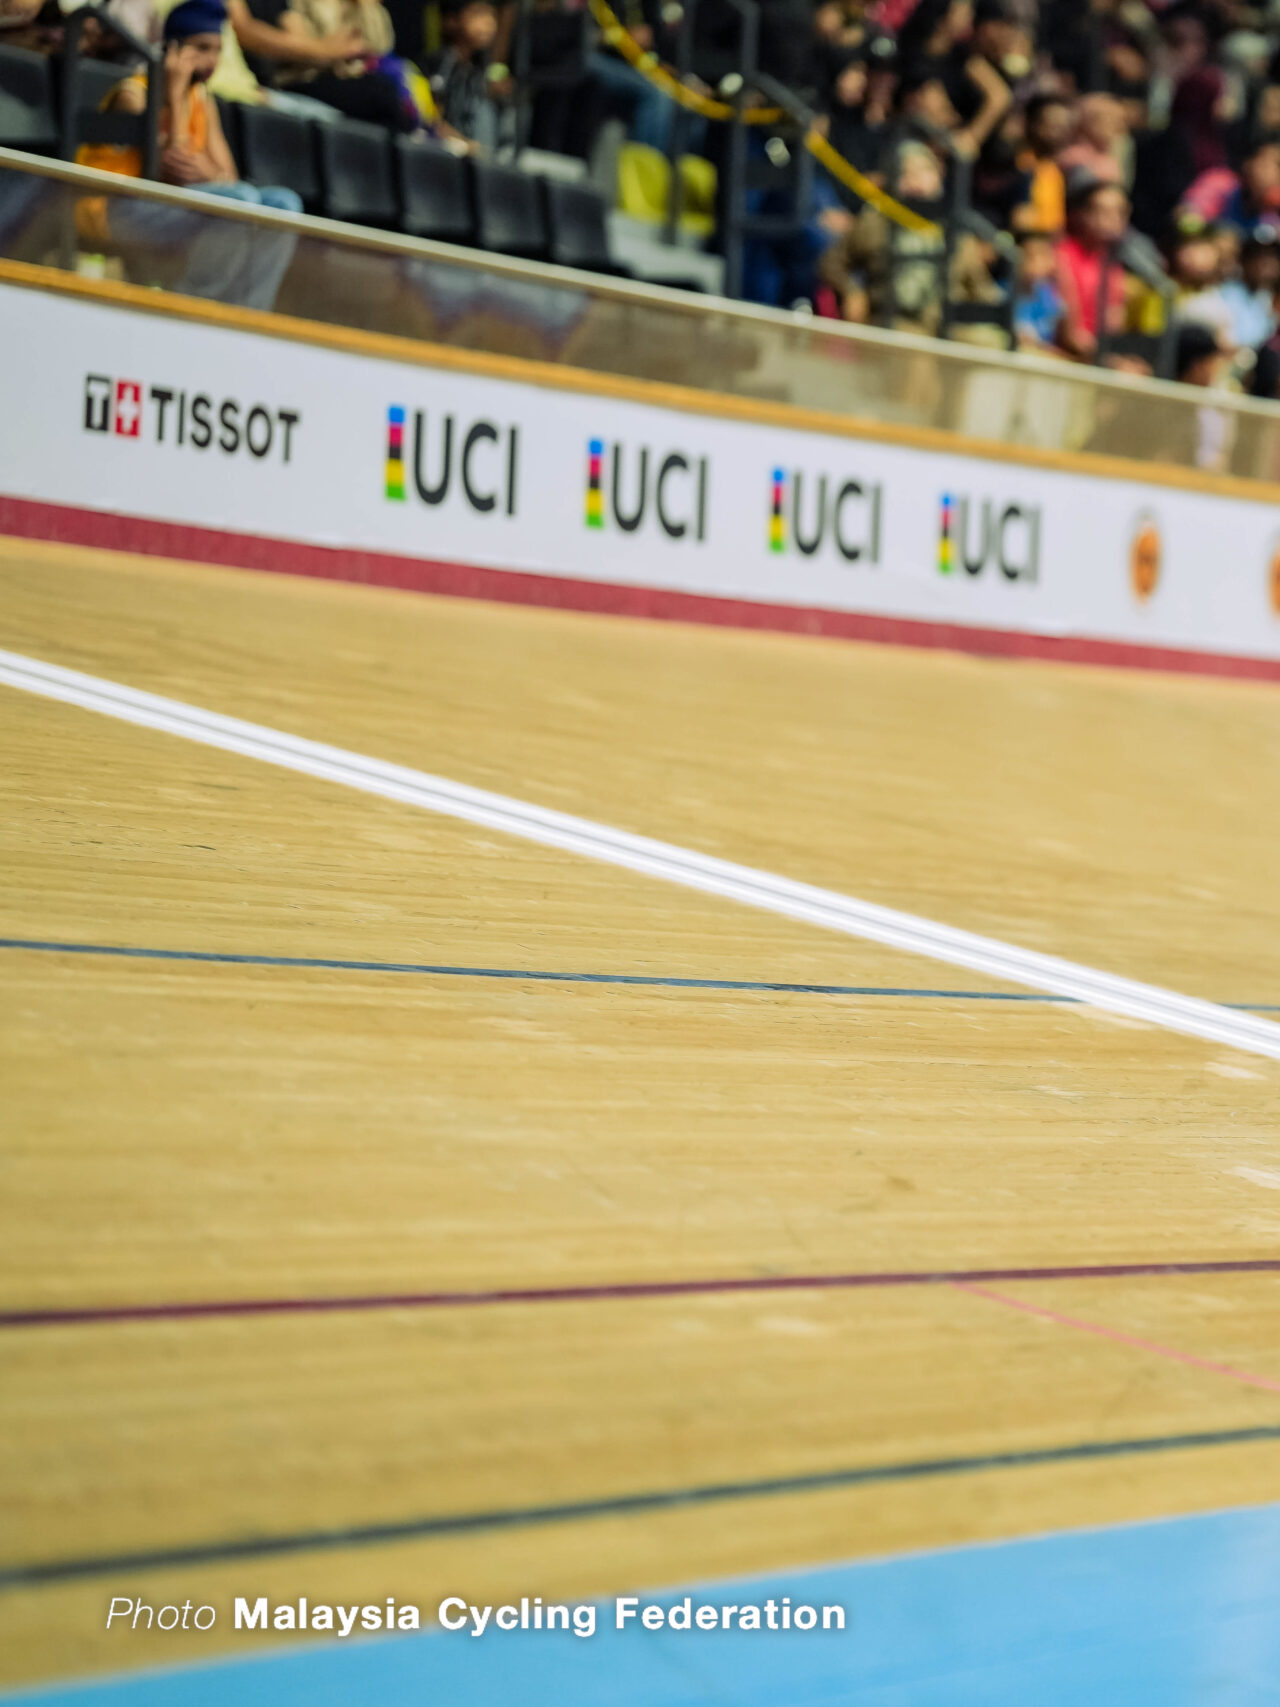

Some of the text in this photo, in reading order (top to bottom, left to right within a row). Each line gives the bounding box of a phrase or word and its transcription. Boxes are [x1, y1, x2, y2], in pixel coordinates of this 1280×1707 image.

[150, 386, 299, 462] TISSOT
[413, 410, 518, 516] UCI
[612, 443, 706, 542] UCI
[793, 470, 882, 563] UCI
[958, 495, 1041, 583] UCI
